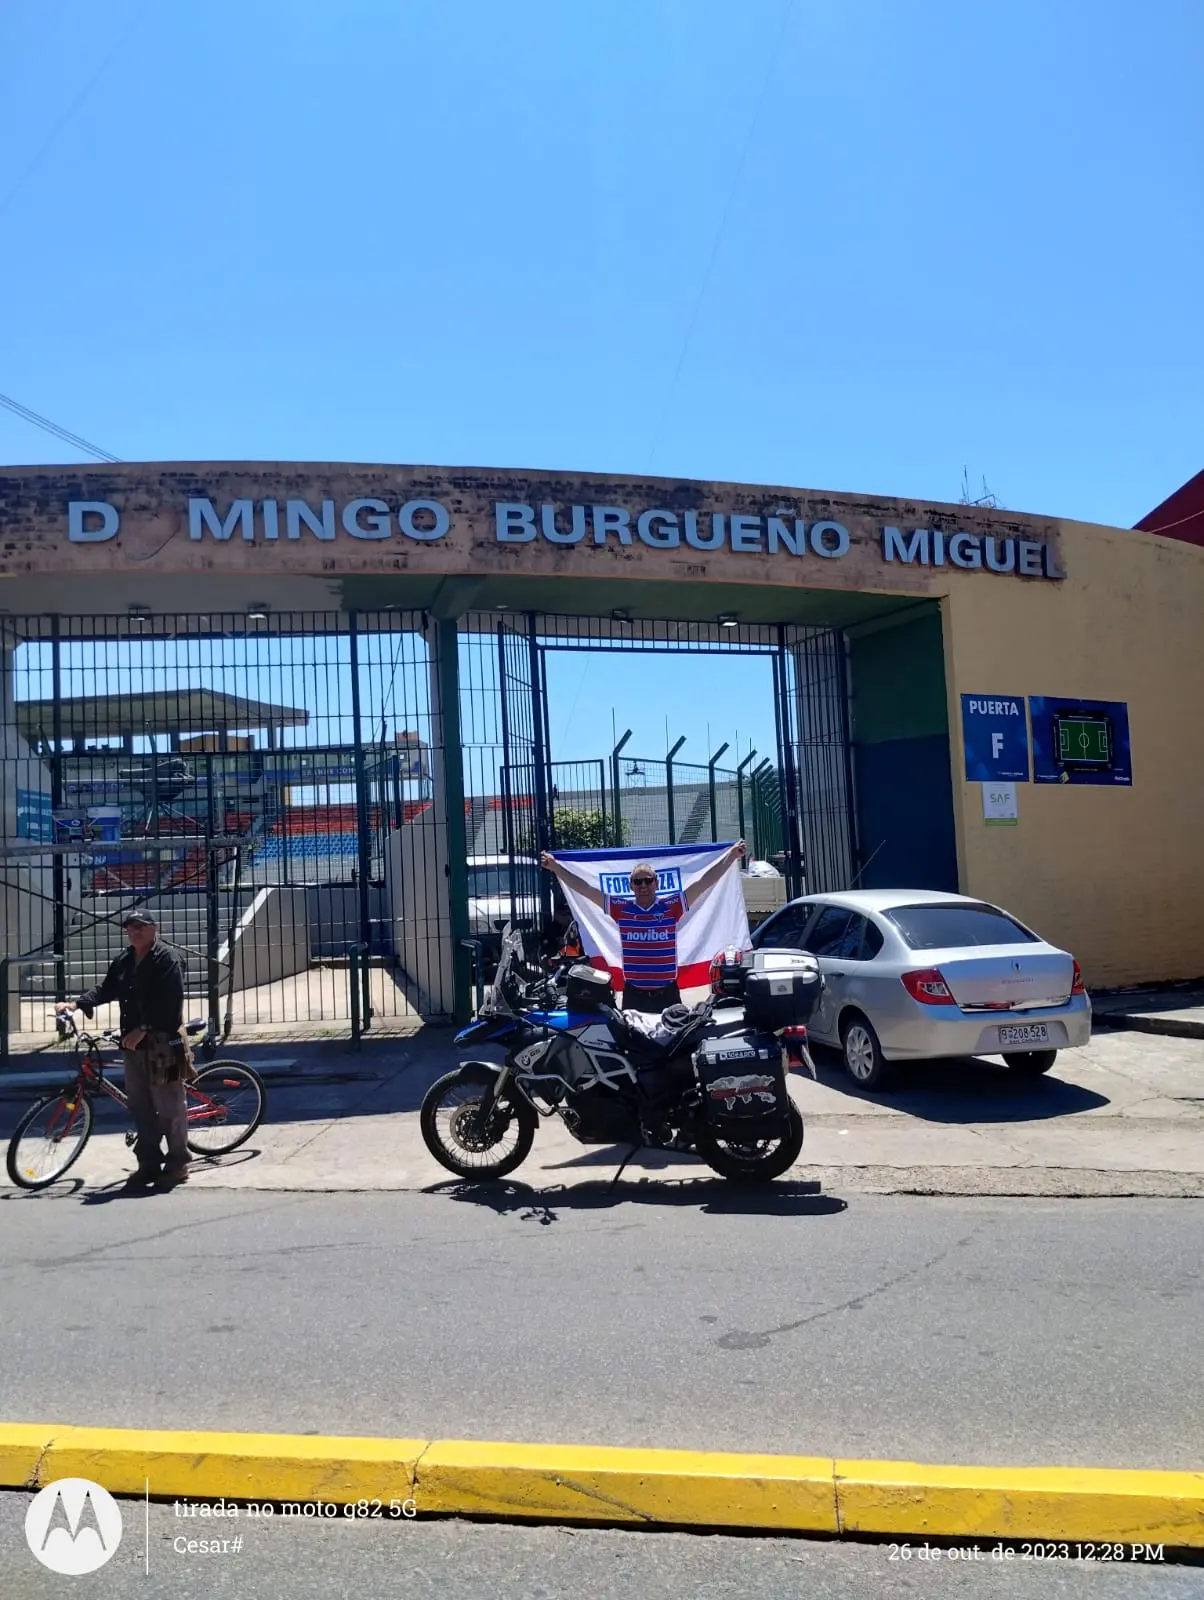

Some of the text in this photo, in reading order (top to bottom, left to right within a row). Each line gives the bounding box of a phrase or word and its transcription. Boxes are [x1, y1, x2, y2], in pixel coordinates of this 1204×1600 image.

[495, 502, 851, 560] BURGUEÑO
[883, 526, 1067, 579] MIGUEL
[969, 700, 1020, 716] PUERTA
[991, 732, 1004, 759] F
[605, 872, 676, 894] FORZA
[626, 929, 670, 941] novibet
